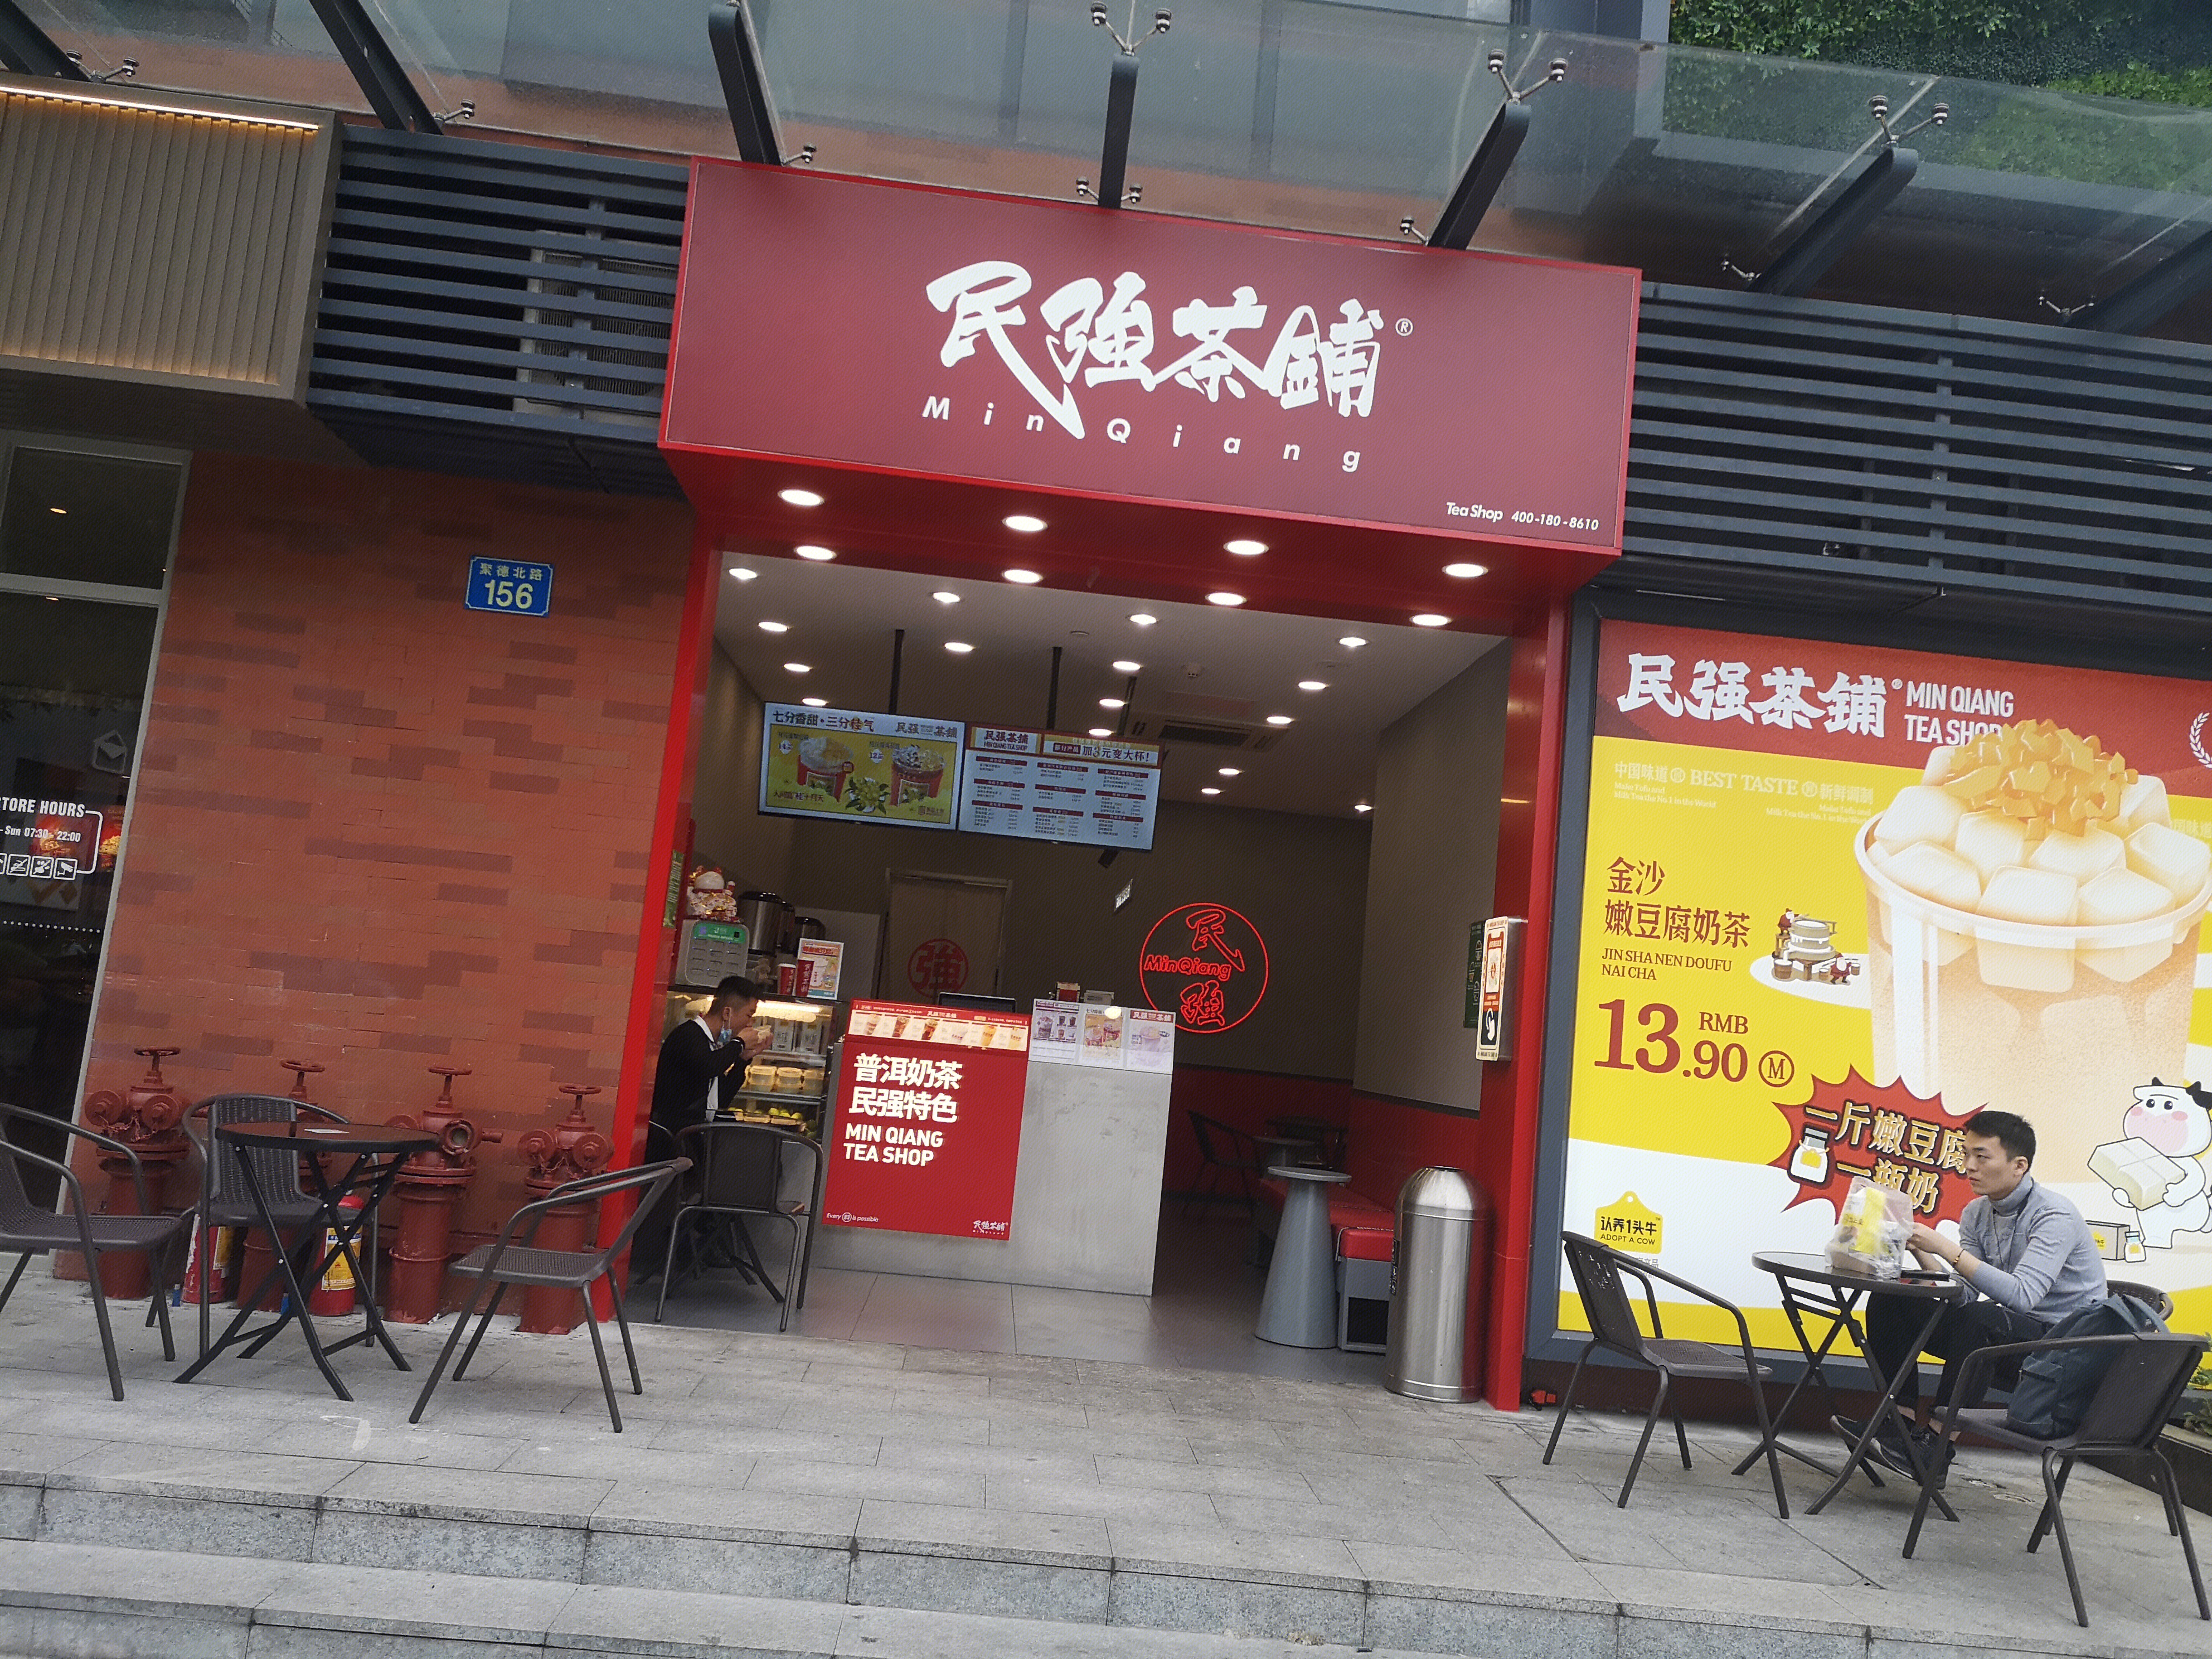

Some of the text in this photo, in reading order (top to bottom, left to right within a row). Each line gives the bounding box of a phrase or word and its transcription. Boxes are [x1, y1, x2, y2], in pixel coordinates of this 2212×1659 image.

[1446, 502, 1469, 517] Tea
[1470, 505, 1503, 522] Shop
[484, 579, 533, 609] 156
[1905, 681, 2014, 717] MIN QIANG
[1904, 714, 1943, 744] TEA
[1614, 761, 1668, 783] 中国味道
[1690, 769, 1736, 789] BEST
[1741, 774, 1798, 795] TASTE
[0, 797, 85, 818] TORE HOURS
[4, 825, 21, 836] Sun
[24, 827, 48, 838] 07:30
[56, 831, 81, 842] 22:00
[1607, 856, 1665, 896] 金沙
[1603, 899, 1751, 948] 嫩豆腐奶茶
[1186, 908, 1245, 972] 民
[1143, 954, 1231, 982] MinQiang
[1602, 948, 1732, 972] JIN SHA NEN DOUFU
[1602, 963, 1657, 980] NAI CHA
[1699, 1011, 1748, 1034] RMB
[853, 1052, 963, 1090] 普洱奶茶
[848, 1086, 958, 1123] 民强特色
[845, 1123, 943, 1148] MIN QIANG
[843, 1143, 934, 1166] TEA SHOP
[1600, 1216, 1657, 1236] 认养1头牛
[1600, 1234, 1627, 1243] ADOPT
